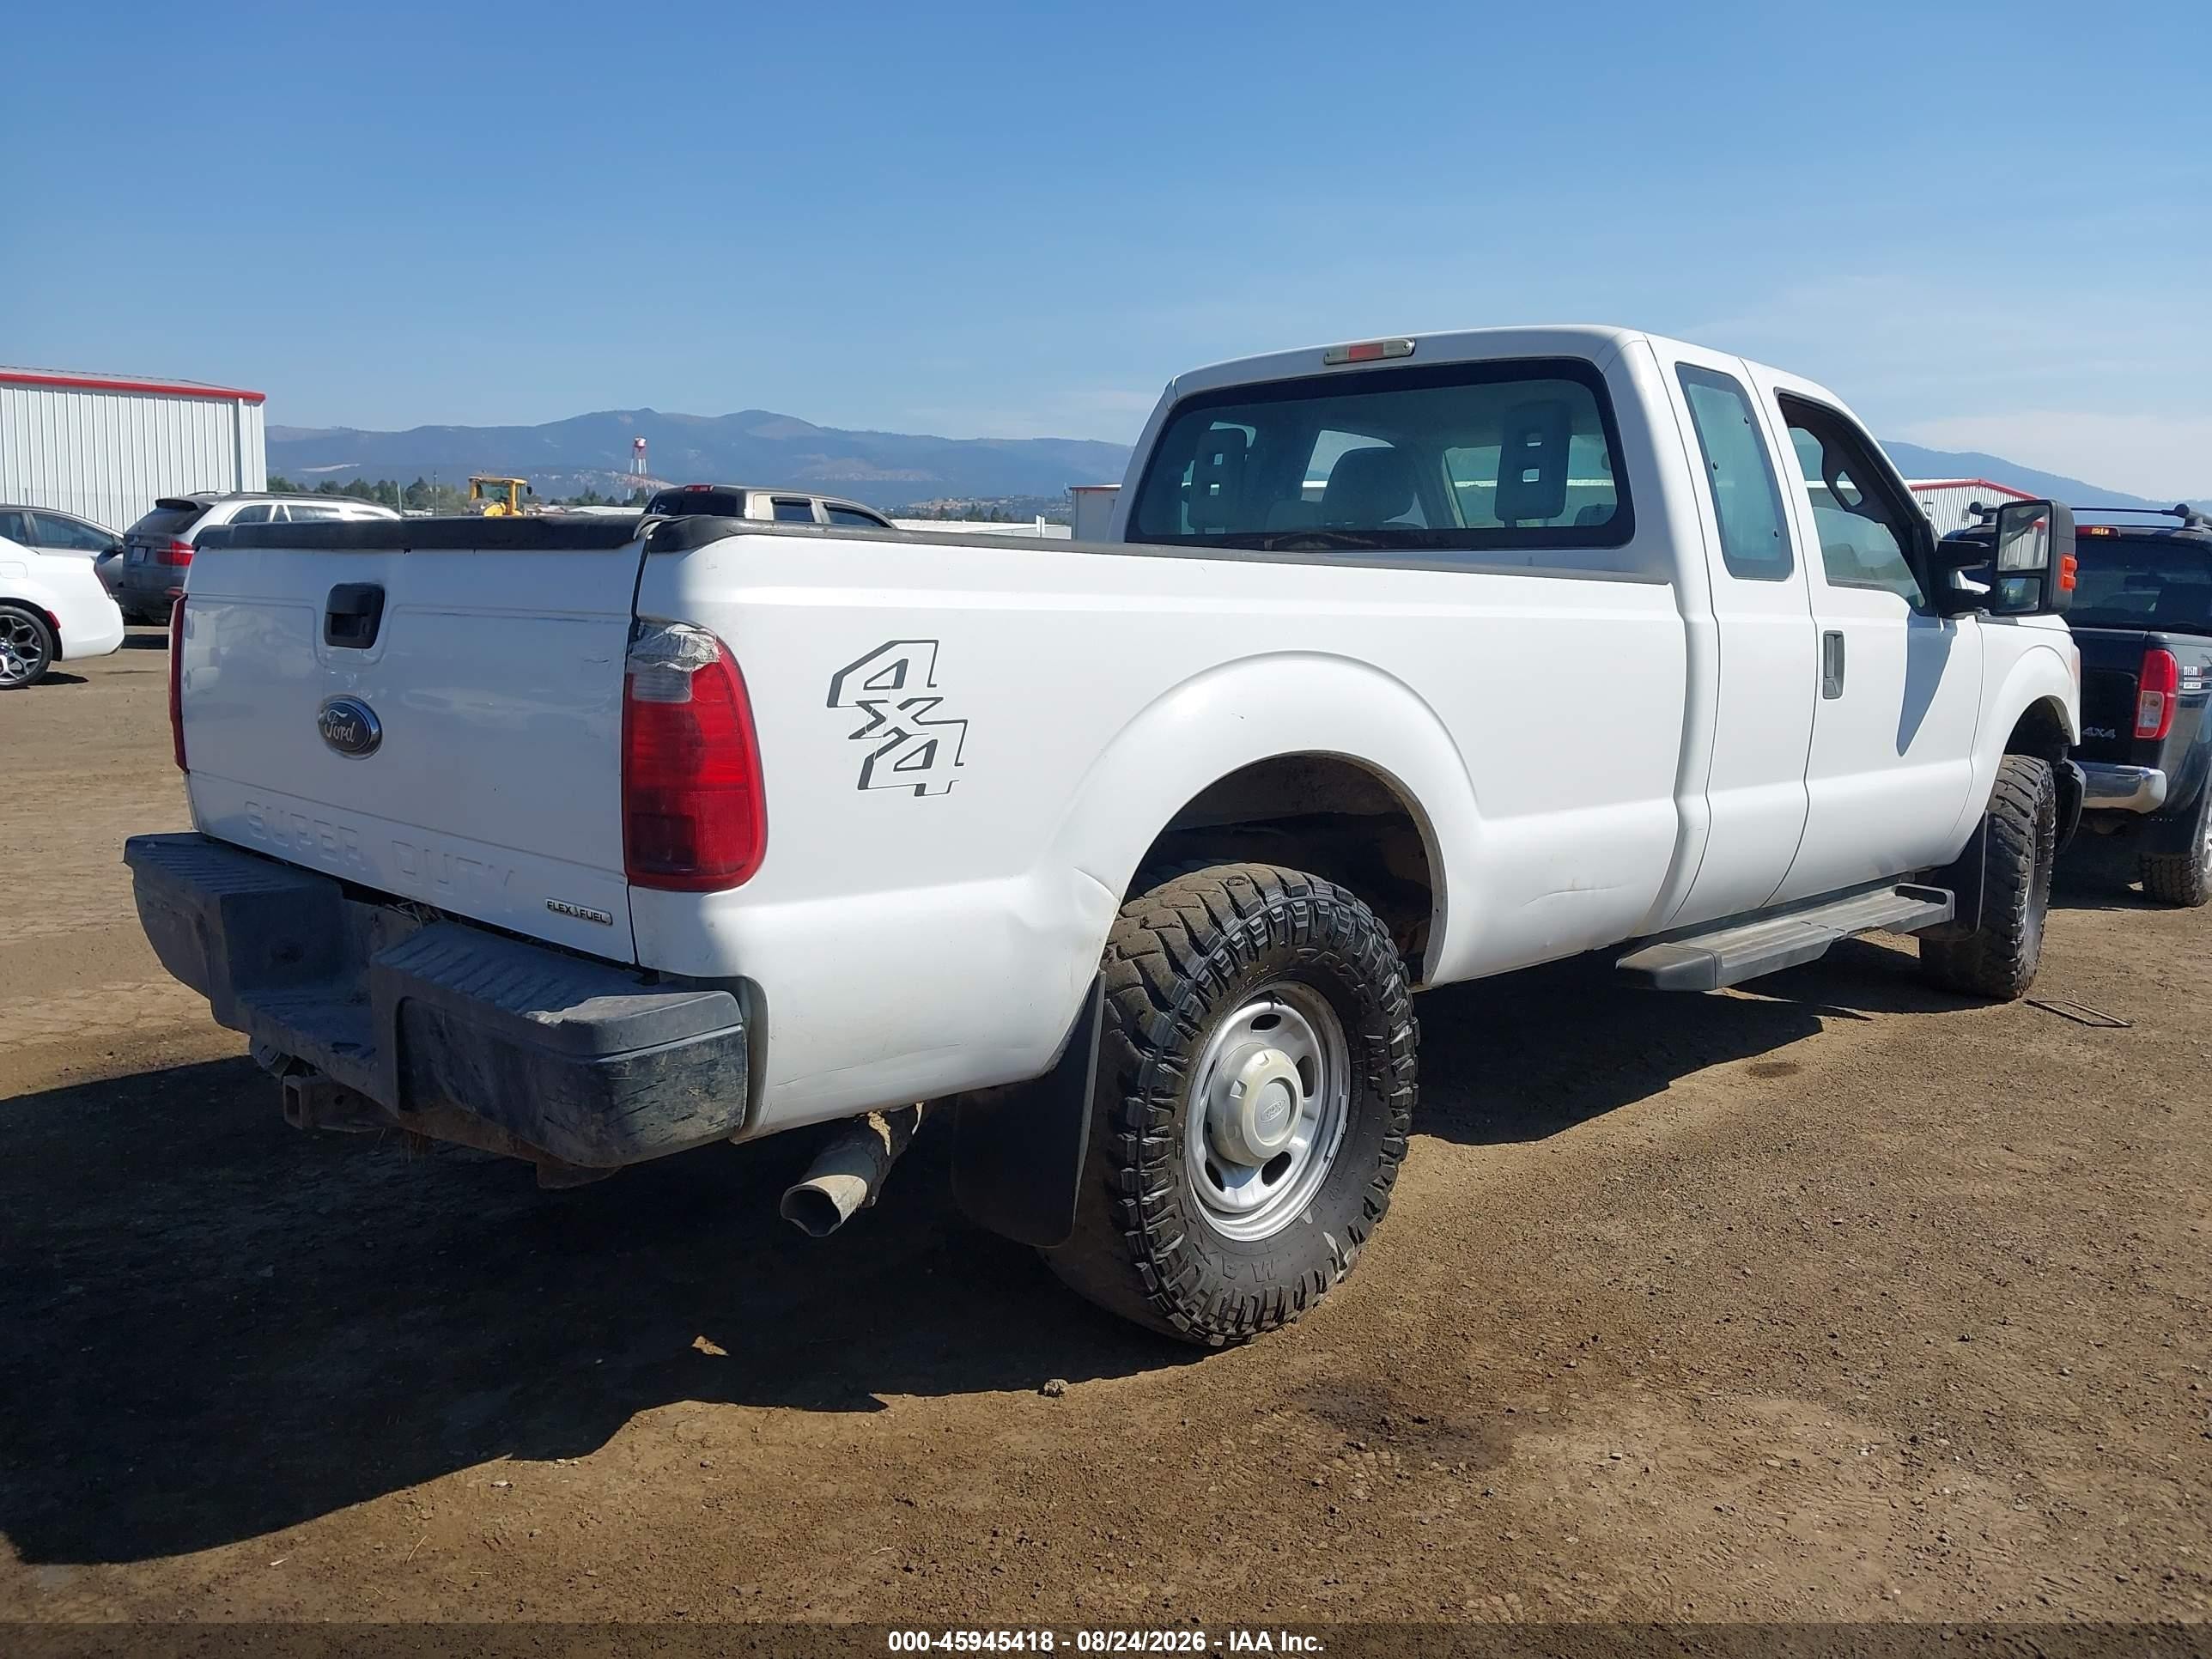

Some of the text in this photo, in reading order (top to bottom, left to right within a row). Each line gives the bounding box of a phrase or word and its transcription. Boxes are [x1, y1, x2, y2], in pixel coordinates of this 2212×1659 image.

[324, 708, 356, 743] Ford
[244, 800, 517, 914] SUPER DUTY
[546, 900, 608, 924] FLEX FUEL
